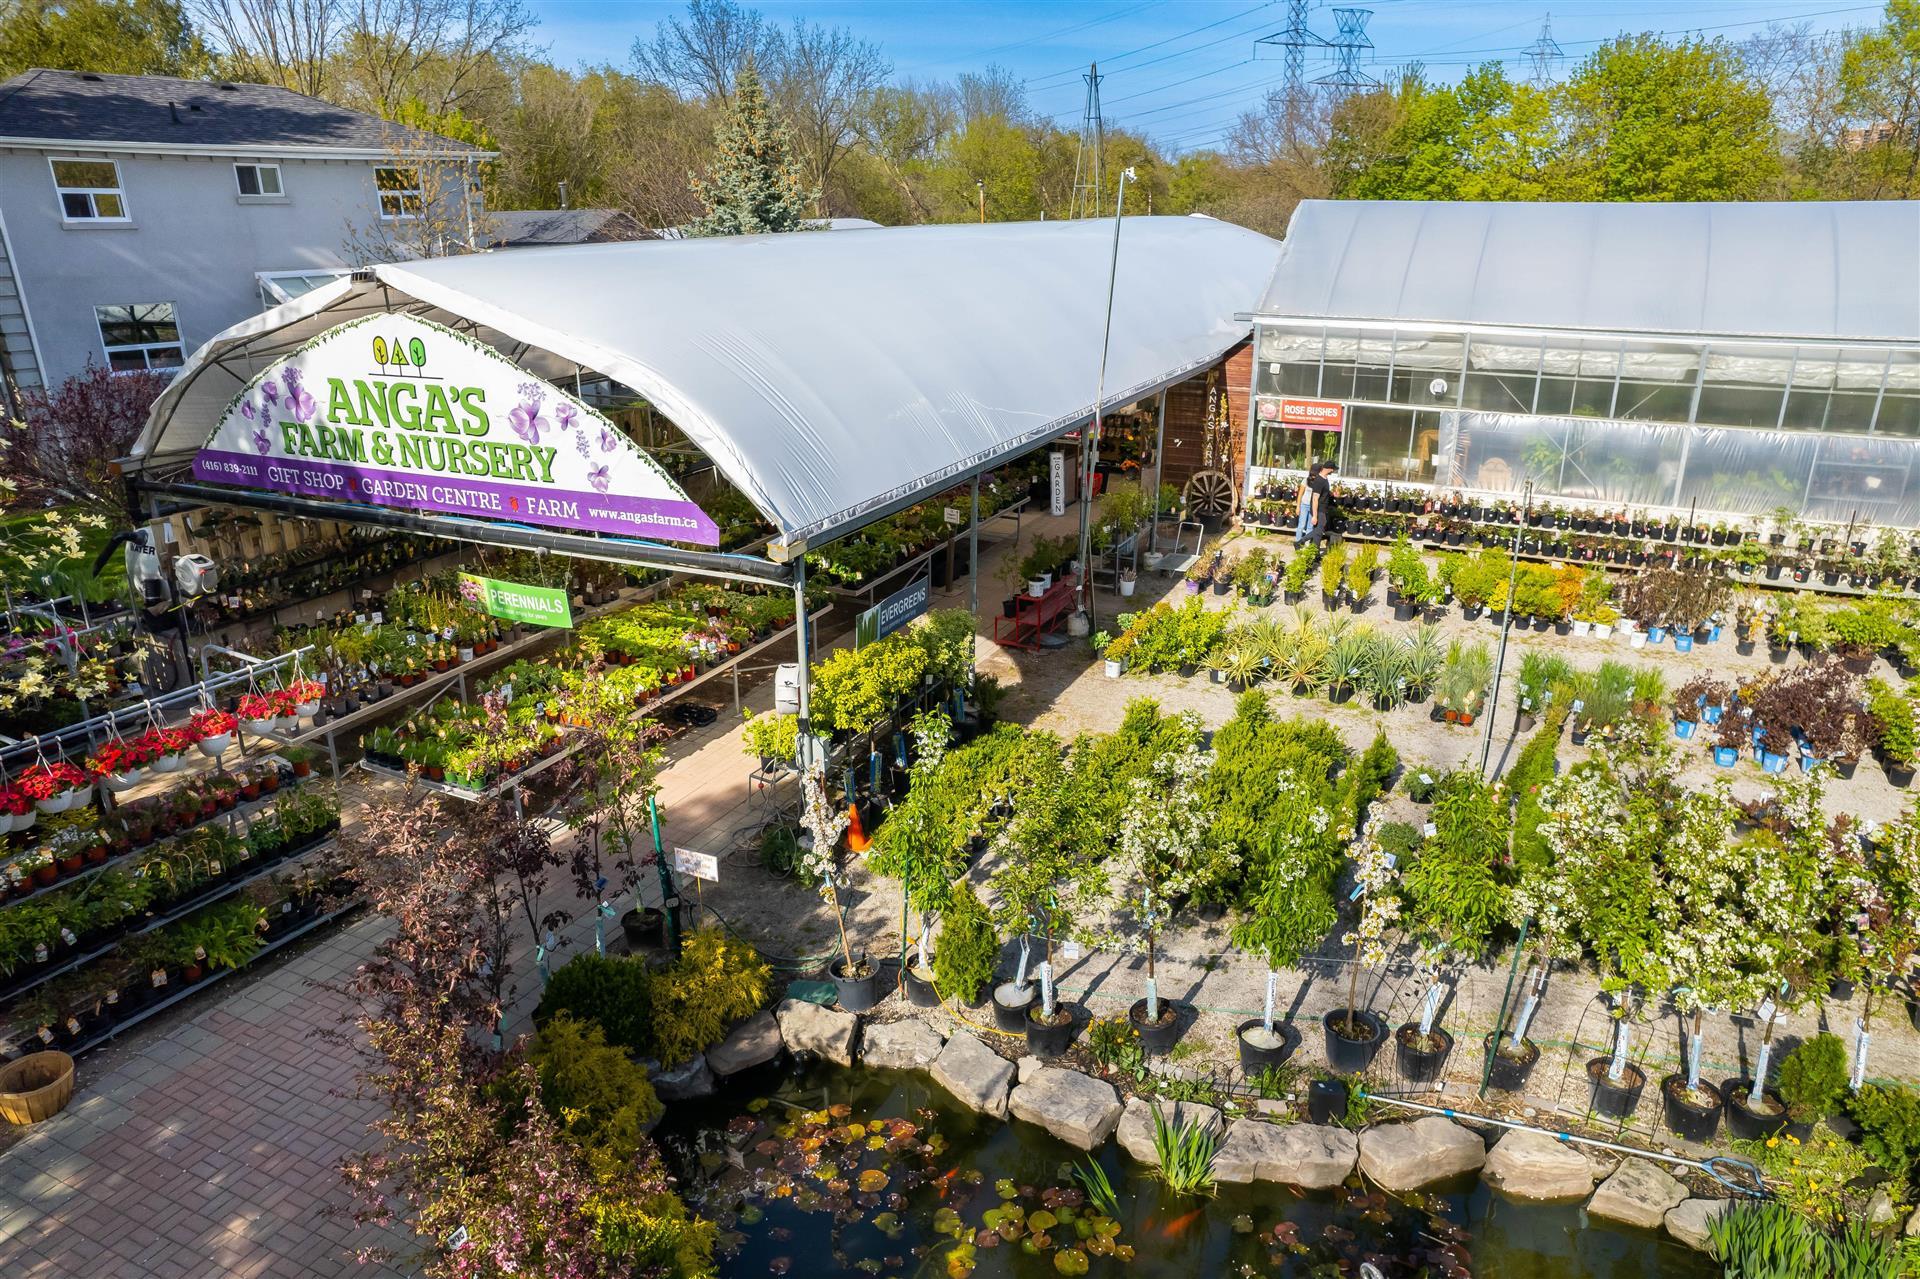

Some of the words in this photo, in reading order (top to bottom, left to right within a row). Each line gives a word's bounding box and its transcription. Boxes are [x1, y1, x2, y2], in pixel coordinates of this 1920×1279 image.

[327, 377, 490, 437] ANGA'S
[1284, 405, 1305, 415] ROSE
[1306, 405, 1338, 417] BUSHES
[280, 421, 369, 463] FARM
[372, 430, 395, 466] &
[396, 433, 558, 483] NURSERY
[202, 460, 222, 472] (416)
[223, 463, 258, 476] 839-2111
[267, 466, 300, 485] GIFT
[304, 470, 344, 490] SHOP
[361, 478, 428, 502] GARDEN
[431, 486, 502, 511] CENTRE
[1054, 463, 1062, 513] GARDEN
[525, 497, 580, 520] FARM
[588, 507, 698, 529] www.angasfarm.ca
[490, 588, 564, 614] PERENNIALS
[881, 587, 926, 625] EVERGREENS
